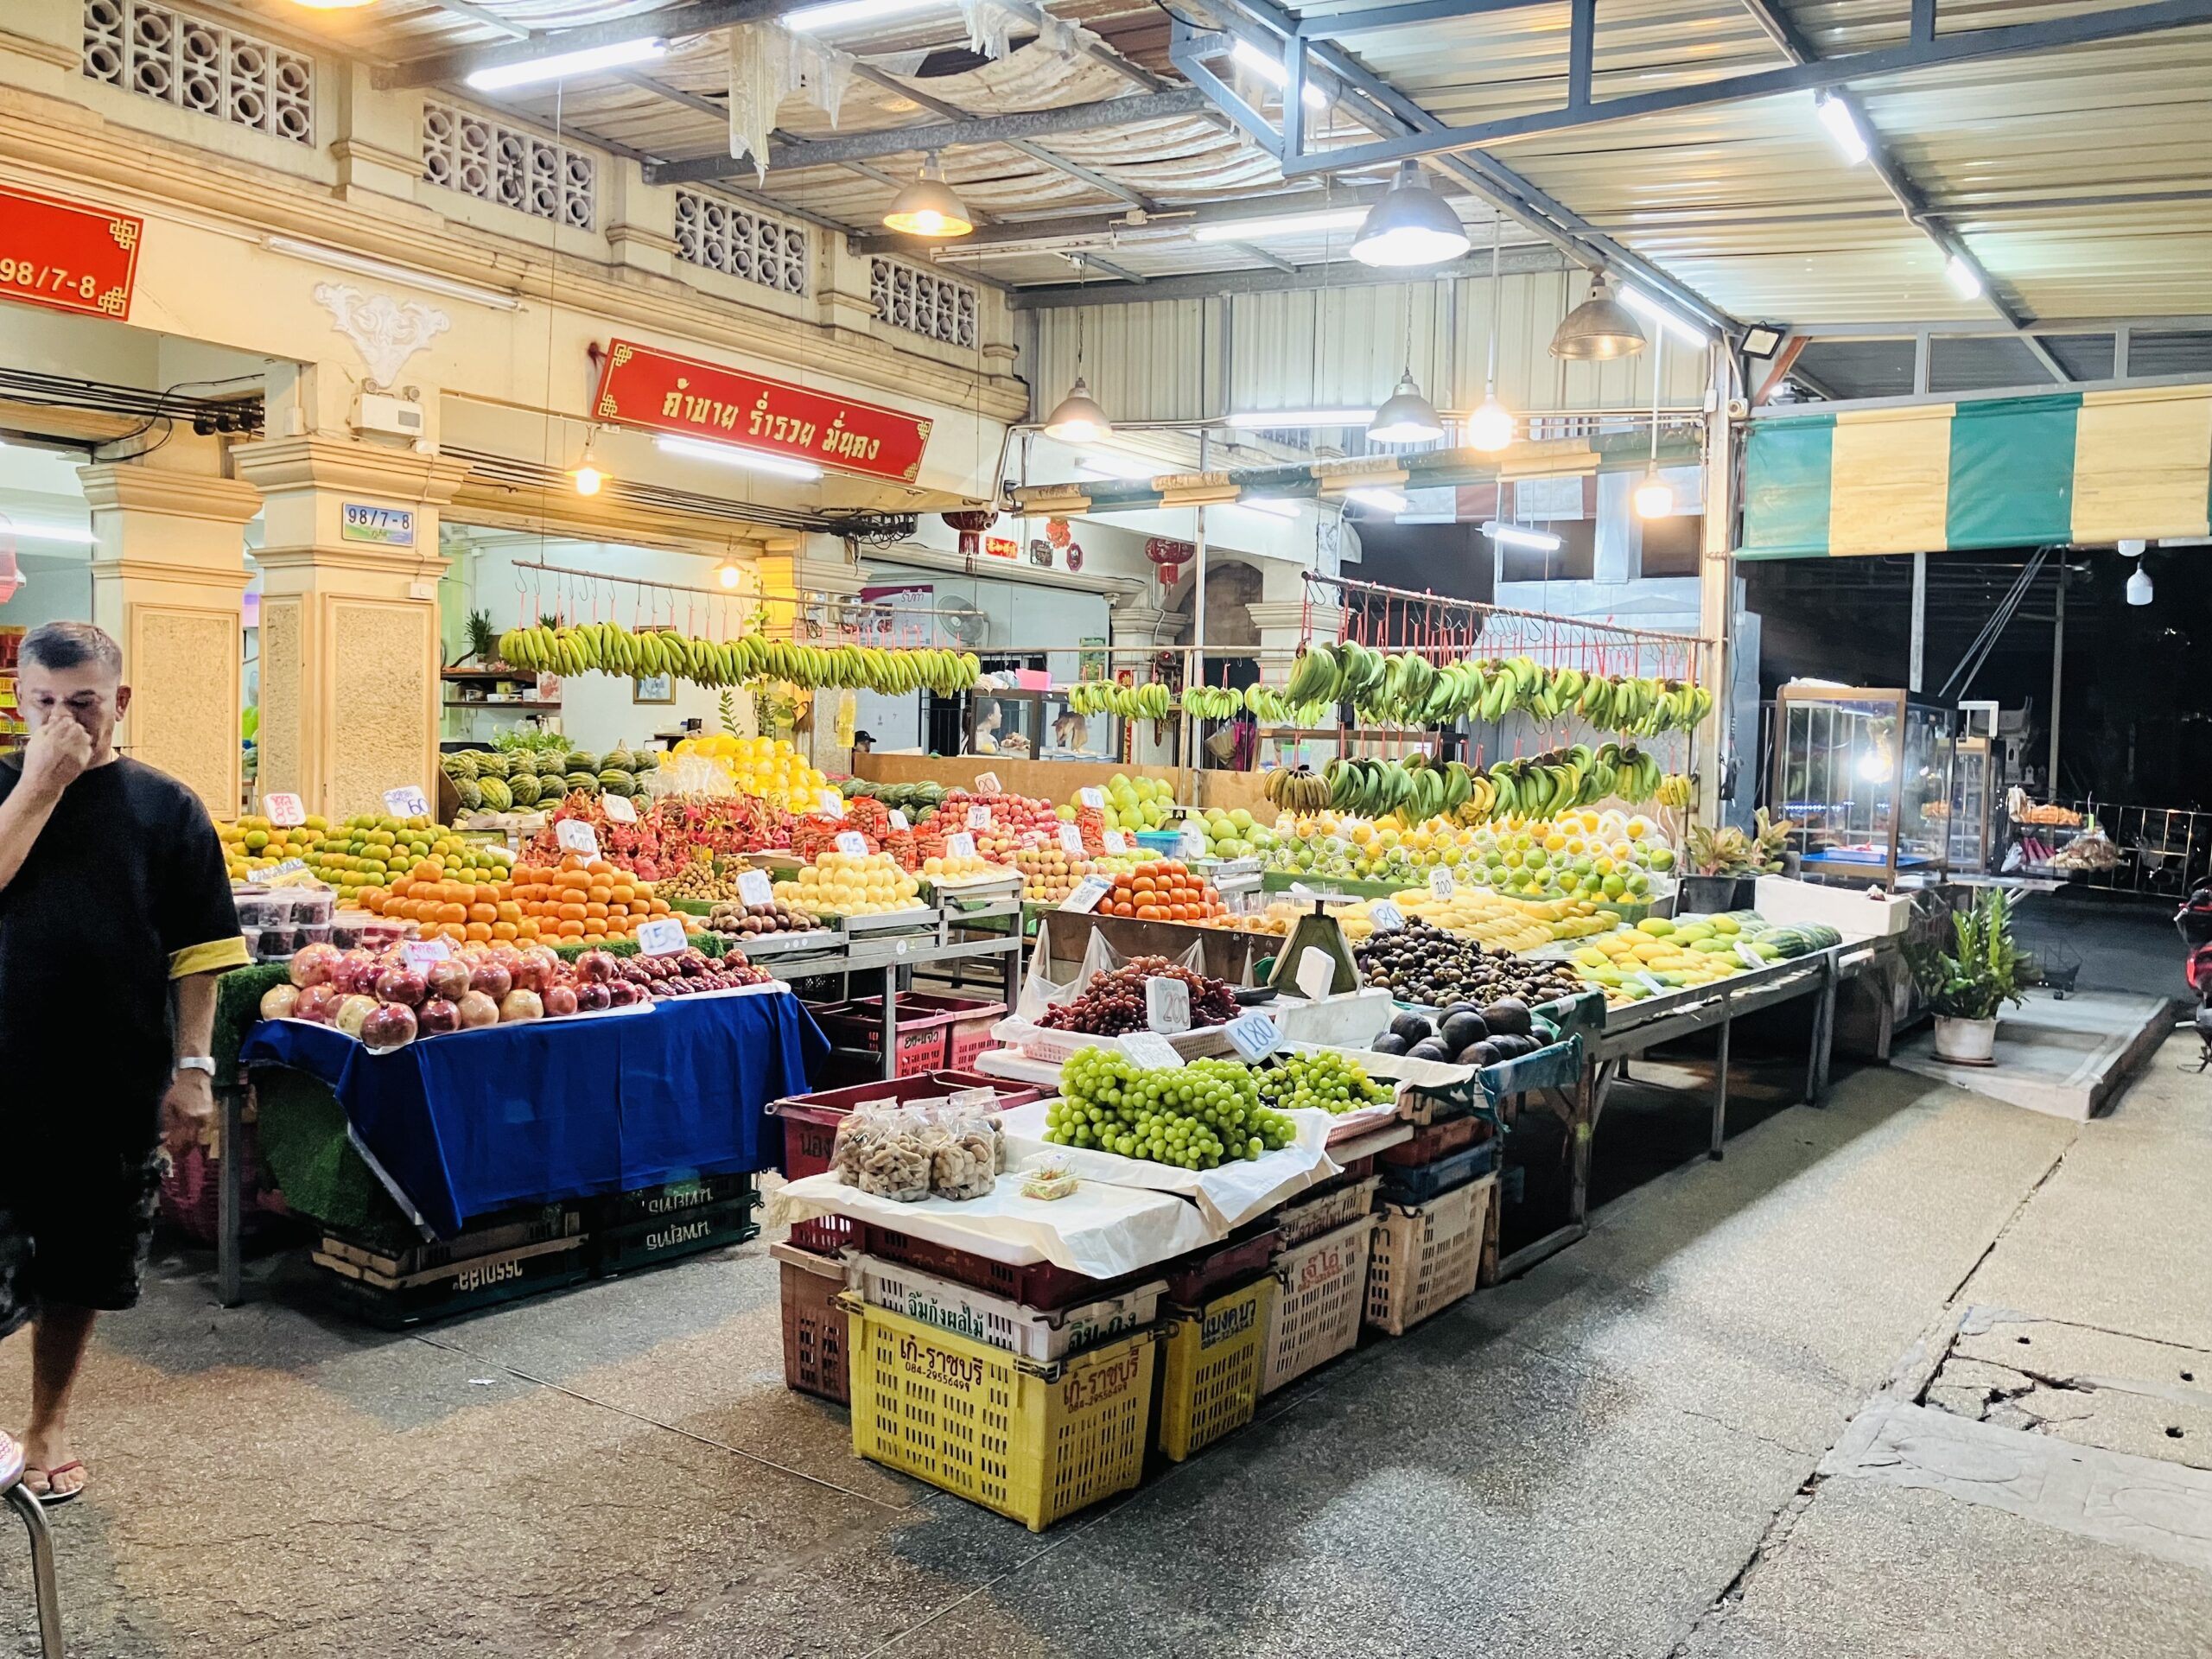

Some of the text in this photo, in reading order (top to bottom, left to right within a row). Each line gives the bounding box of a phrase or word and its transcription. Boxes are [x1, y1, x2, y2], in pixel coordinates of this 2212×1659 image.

[0, 257, 96, 299] 98/7-8
[661, 378, 880, 460] ค้าขาย ร่ำรวย มั่นคง
[348, 507, 410, 530] 98/7-8
[275, 807, 299, 823] 85
[407, 798, 429, 816] 60
[974, 813, 985, 827] 15
[843, 837, 862, 853] 25
[1435, 880, 1451, 895] 100
[1163, 992, 1189, 1027] 200
[1237, 1017, 1274, 1052] 180
[906, 1362, 965, 1390] 084-2955649
